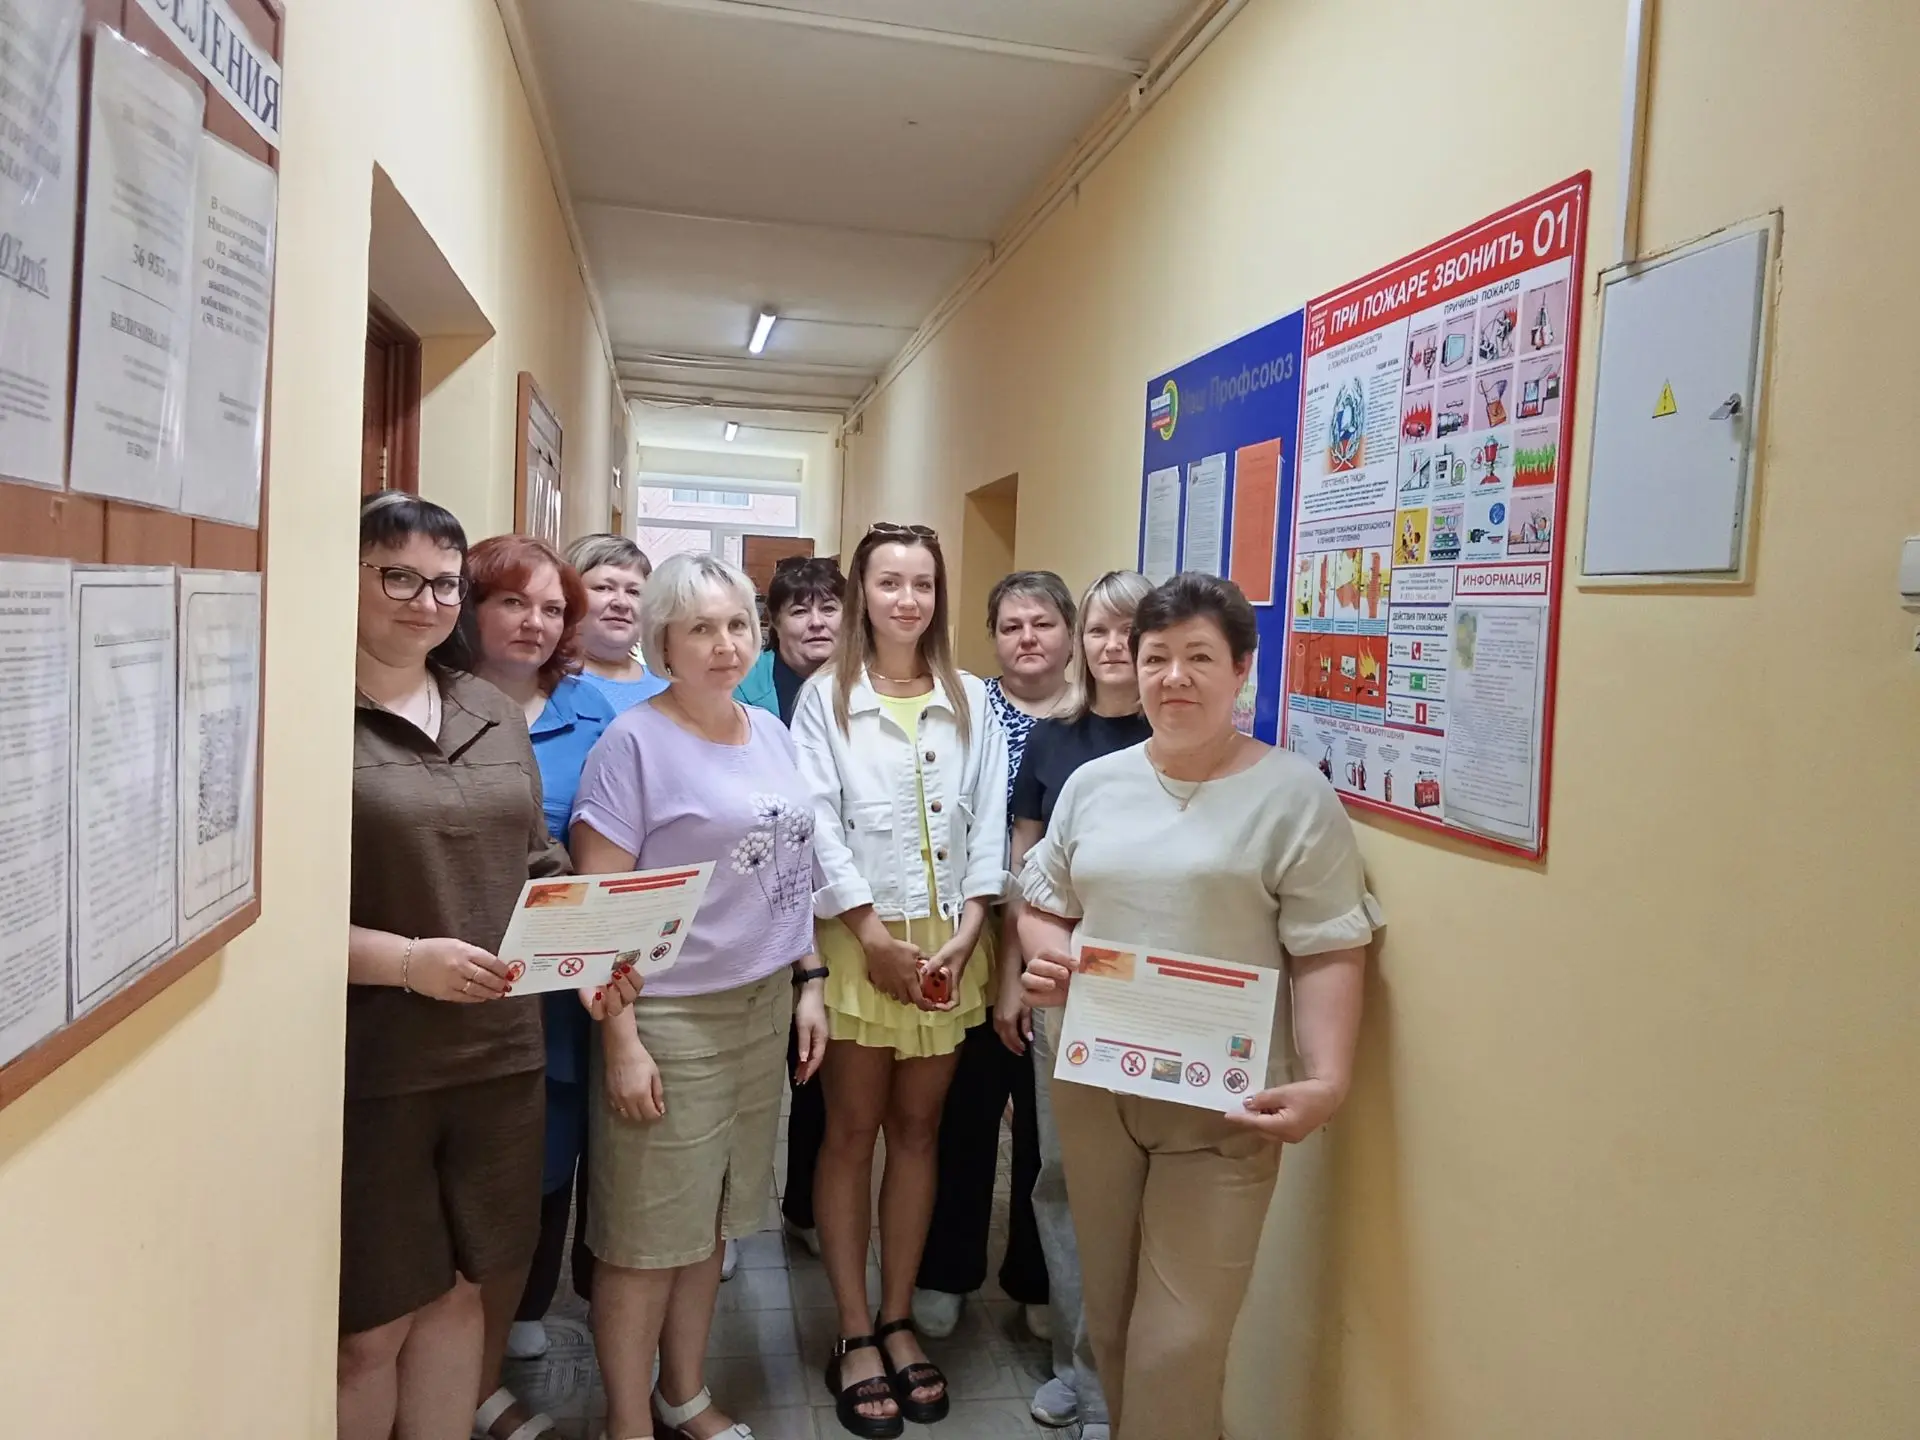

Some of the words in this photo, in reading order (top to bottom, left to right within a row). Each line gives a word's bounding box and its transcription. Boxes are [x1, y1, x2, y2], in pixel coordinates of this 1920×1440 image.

[1330, 301, 1360, 335] ПРИ
[1361, 270, 1429, 322] ПОЖАРЕ
[1431, 231, 1524, 293] ЗВОНИТЬ
[1532, 201, 1570, 258] 01
[1444, 294, 1479, 315] ПРИЧИНЫ
[1481, 278, 1521, 303] ПОЖАРОВ
[1310, 324, 1326, 352] 112
[1210, 352, 1294, 412] Профсоюз
[1463, 572, 1542, 587] ИНФОРМАЦИЯ
[1392, 610, 1416, 621] ДЕЙСТВИЯ
[1417, 611, 1426, 621] ПРИ
[1426, 611, 1448, 621] ПОЖАРЕ
[1389, 641, 1393, 658] 1
[1388, 670, 1393, 687] 2
[1387, 701, 1393, 718] 3
[1361, 724, 1405, 740] ПОЖАРОТУШЕНИЯ
